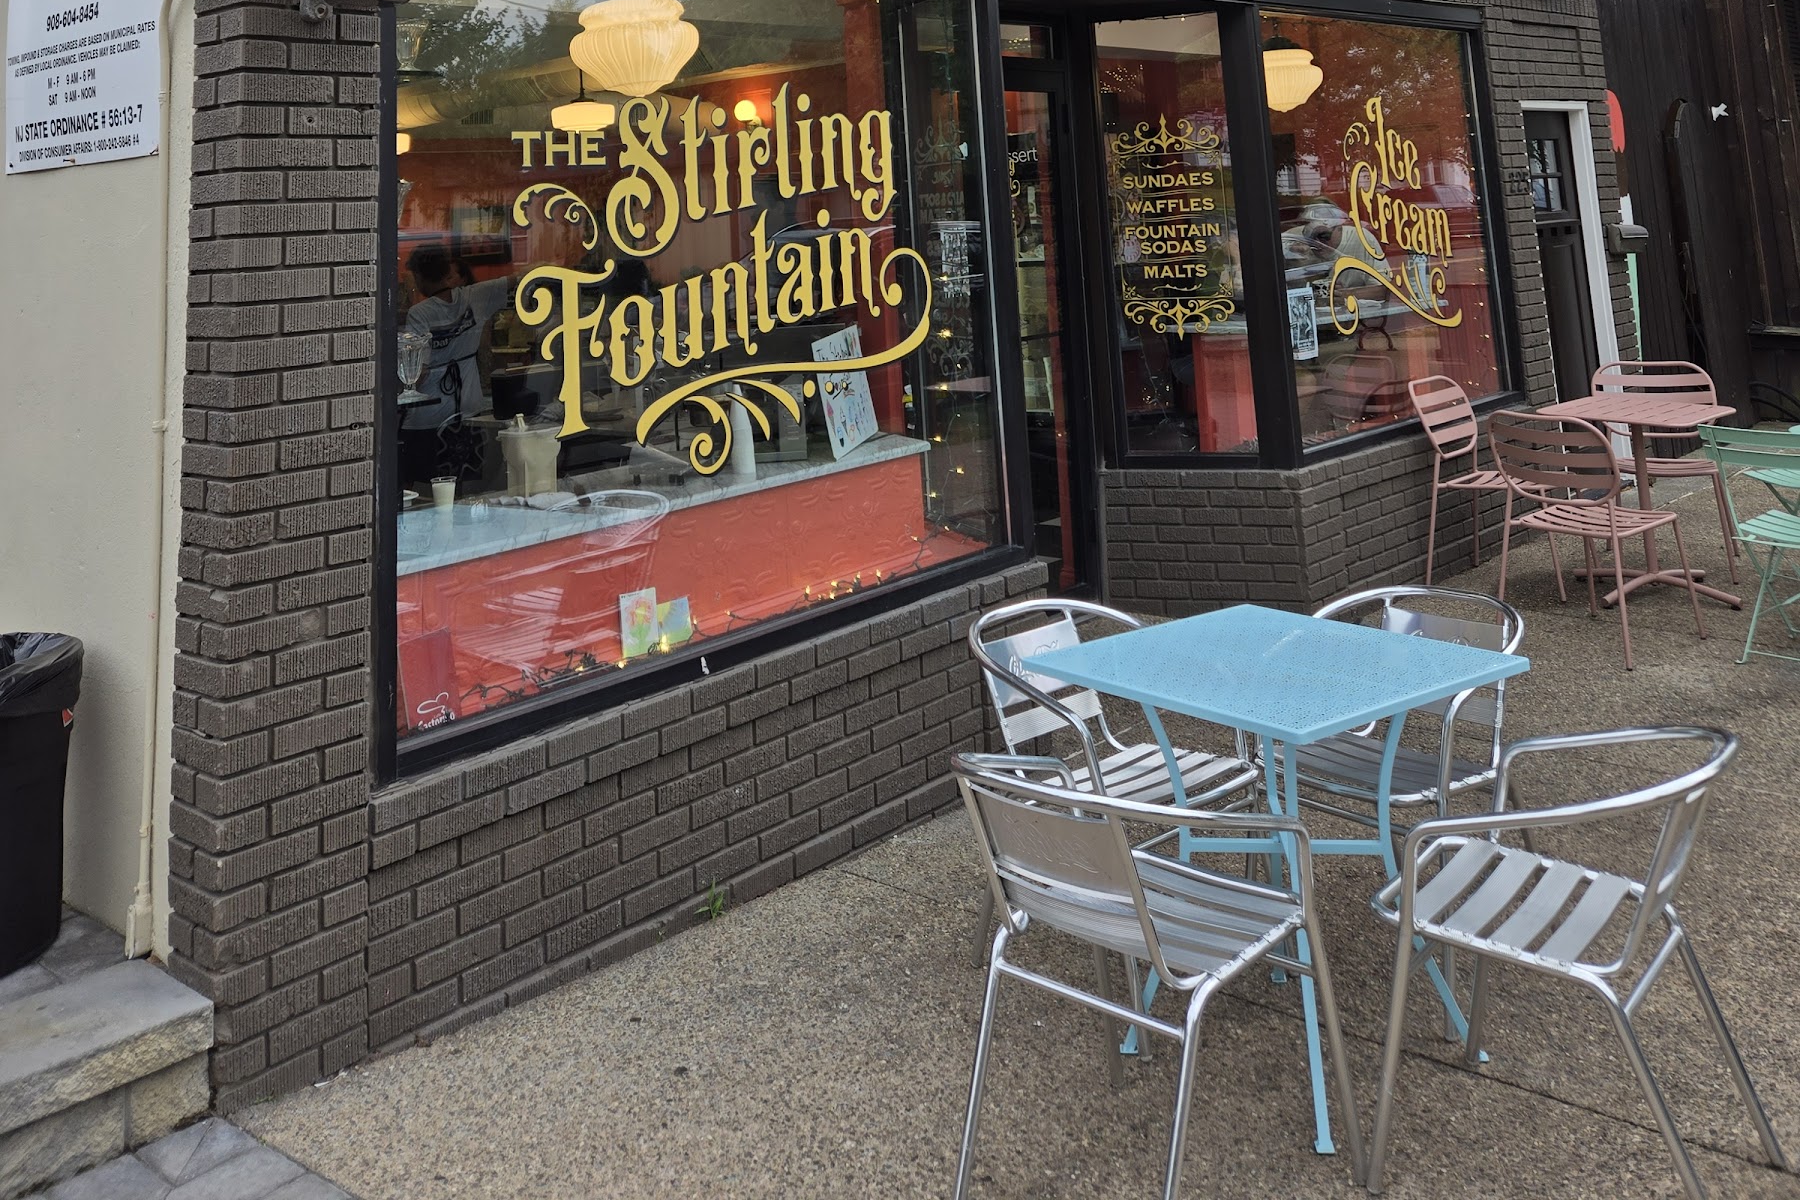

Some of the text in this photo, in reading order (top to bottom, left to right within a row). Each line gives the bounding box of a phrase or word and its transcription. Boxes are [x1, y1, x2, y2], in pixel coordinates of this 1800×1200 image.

[46, 1, 99, 32] 908-604-8454
[40, 44, 58, 58] STORAGE
[58, 40, 78, 53] CHARGES
[78, 37, 87, 49] ARE
[87, 33, 102, 46] BASED
[102, 31, 110, 42] ON
[110, 25, 136, 40] MUNICIPAL
[137, 20, 156, 34] RATES
[40, 60, 52, 72] LOCAL
[77, 49, 98, 63] VEHICLES
[109, 44, 116, 55] BE
[66, 74, 69, 85] 9
[70, 72, 79, 84] AM
[83, 70, 87, 82] 6
[87, 68, 96, 81] PM
[48, 94, 58, 106] SAT
[64, 92, 68, 103] 9
[69, 90, 77, 102] AM
[80, 86, 97, 100] NOON
[15, 124, 24, 143] NJ
[25, 120, 48, 141] STATE
[50, 112, 99, 137] ORDINANCE
[108, 104, 143, 128] 56:13-7
[19, 150, 37, 162] DIVISION
[37, 148, 44, 159] OF
[44, 144, 73, 158] CONSUMER
[1365, 96, 1422, 190] Ice
[511, 81, 898, 258] THE Stirling
[1122, 172, 1215, 190] SUNDAES
[1508, 170, 1532, 194] 225
[1126, 198, 1215, 214] WAFFLES
[1349, 161, 1453, 268] Cream
[1124, 223, 1221, 240] FOUNTAIN
[1140, 239, 1207, 255] SODAS
[1143, 264, 1208, 279] MALTS
[515, 208, 881, 440] Fountain
